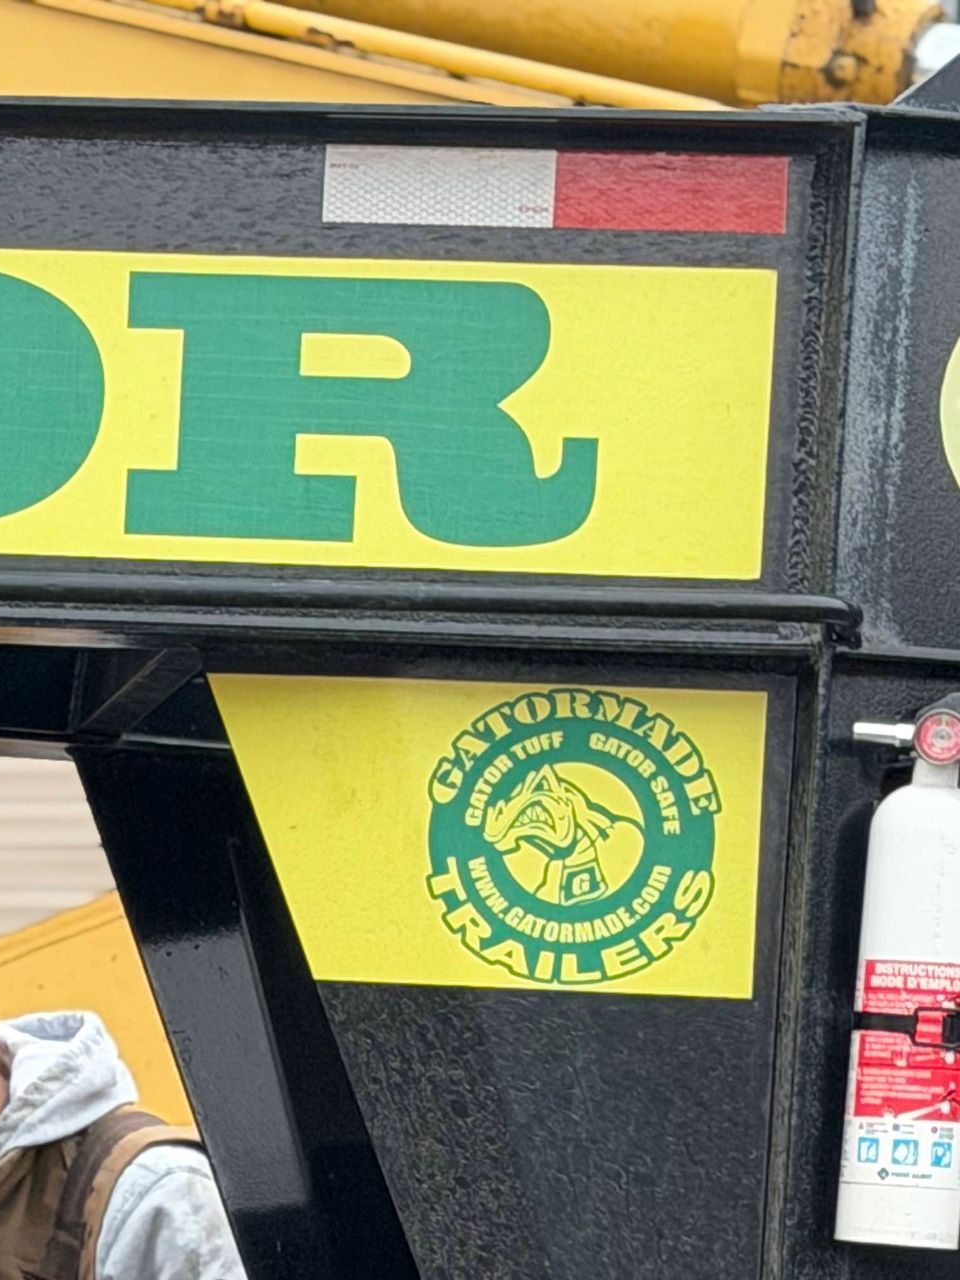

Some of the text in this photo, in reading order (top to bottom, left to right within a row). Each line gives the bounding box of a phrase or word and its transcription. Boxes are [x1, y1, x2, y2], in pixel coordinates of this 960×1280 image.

[429, 689, 721, 816] GATORMADE
[464, 731, 564, 827] GATOR TUFF
[589, 732, 681, 836] GATOR SAFE
[427, 855, 715, 984] TRAILERS
[571, 872, 591, 895] G
